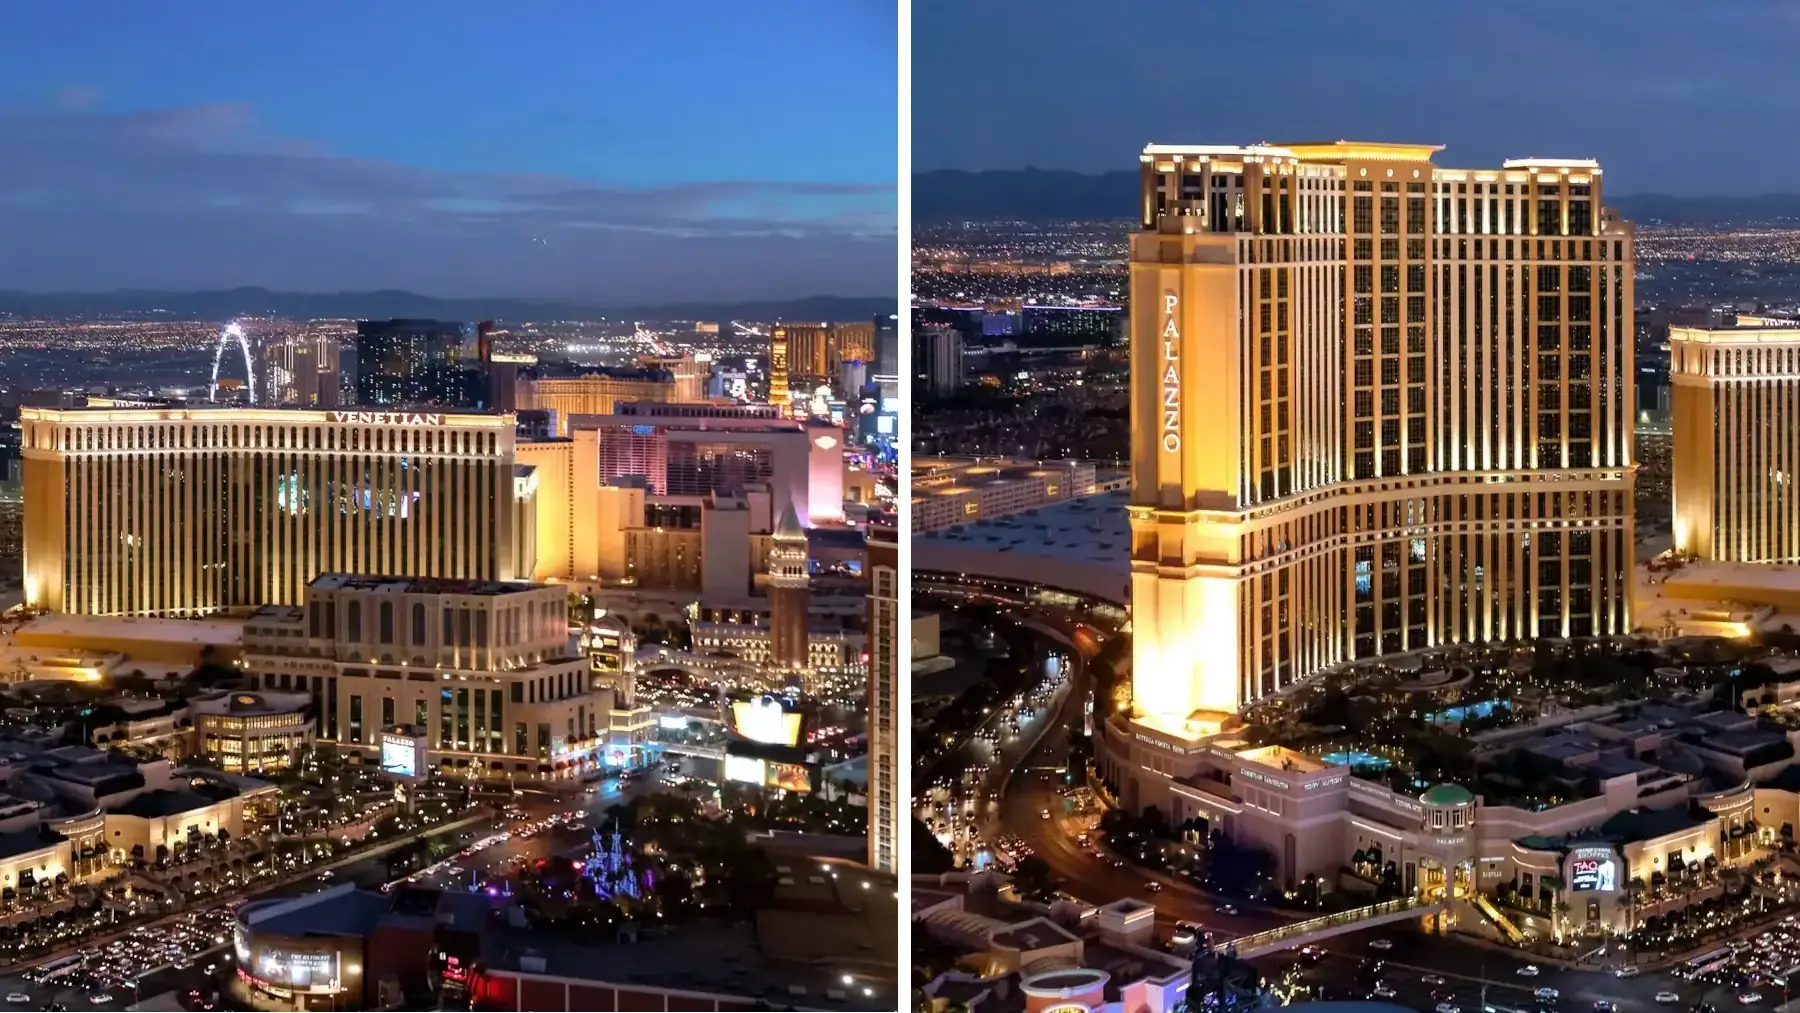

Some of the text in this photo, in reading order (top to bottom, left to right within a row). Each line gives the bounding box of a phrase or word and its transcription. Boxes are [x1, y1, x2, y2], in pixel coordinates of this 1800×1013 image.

[1763, 318, 1800, 327] VENETIA
[1163, 295, 1181, 453] PALAZZO
[333, 411, 441, 426] VENETIAN
[383, 735, 415, 747] PALAZZO
[1436, 836, 1464, 845] PALAZZO
[1573, 861, 1598, 873] TAO
